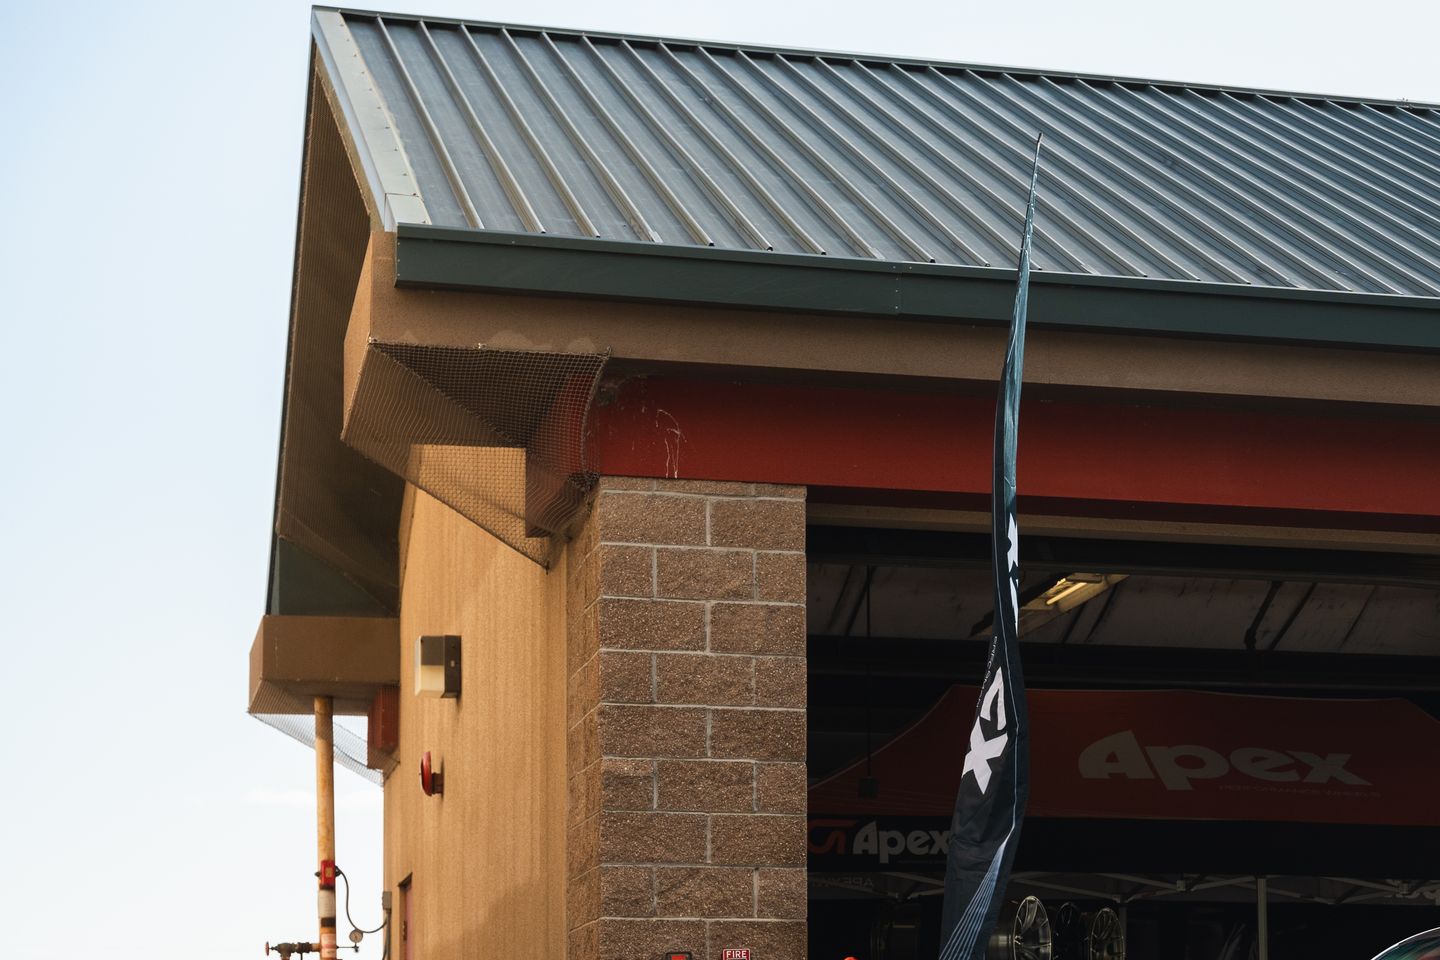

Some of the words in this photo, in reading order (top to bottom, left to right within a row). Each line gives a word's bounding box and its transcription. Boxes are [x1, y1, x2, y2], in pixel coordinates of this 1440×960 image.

[1079, 730, 1374, 790] Apex
[852, 821, 950, 863] Apex
[726, 950, 747, 958] FIRE
